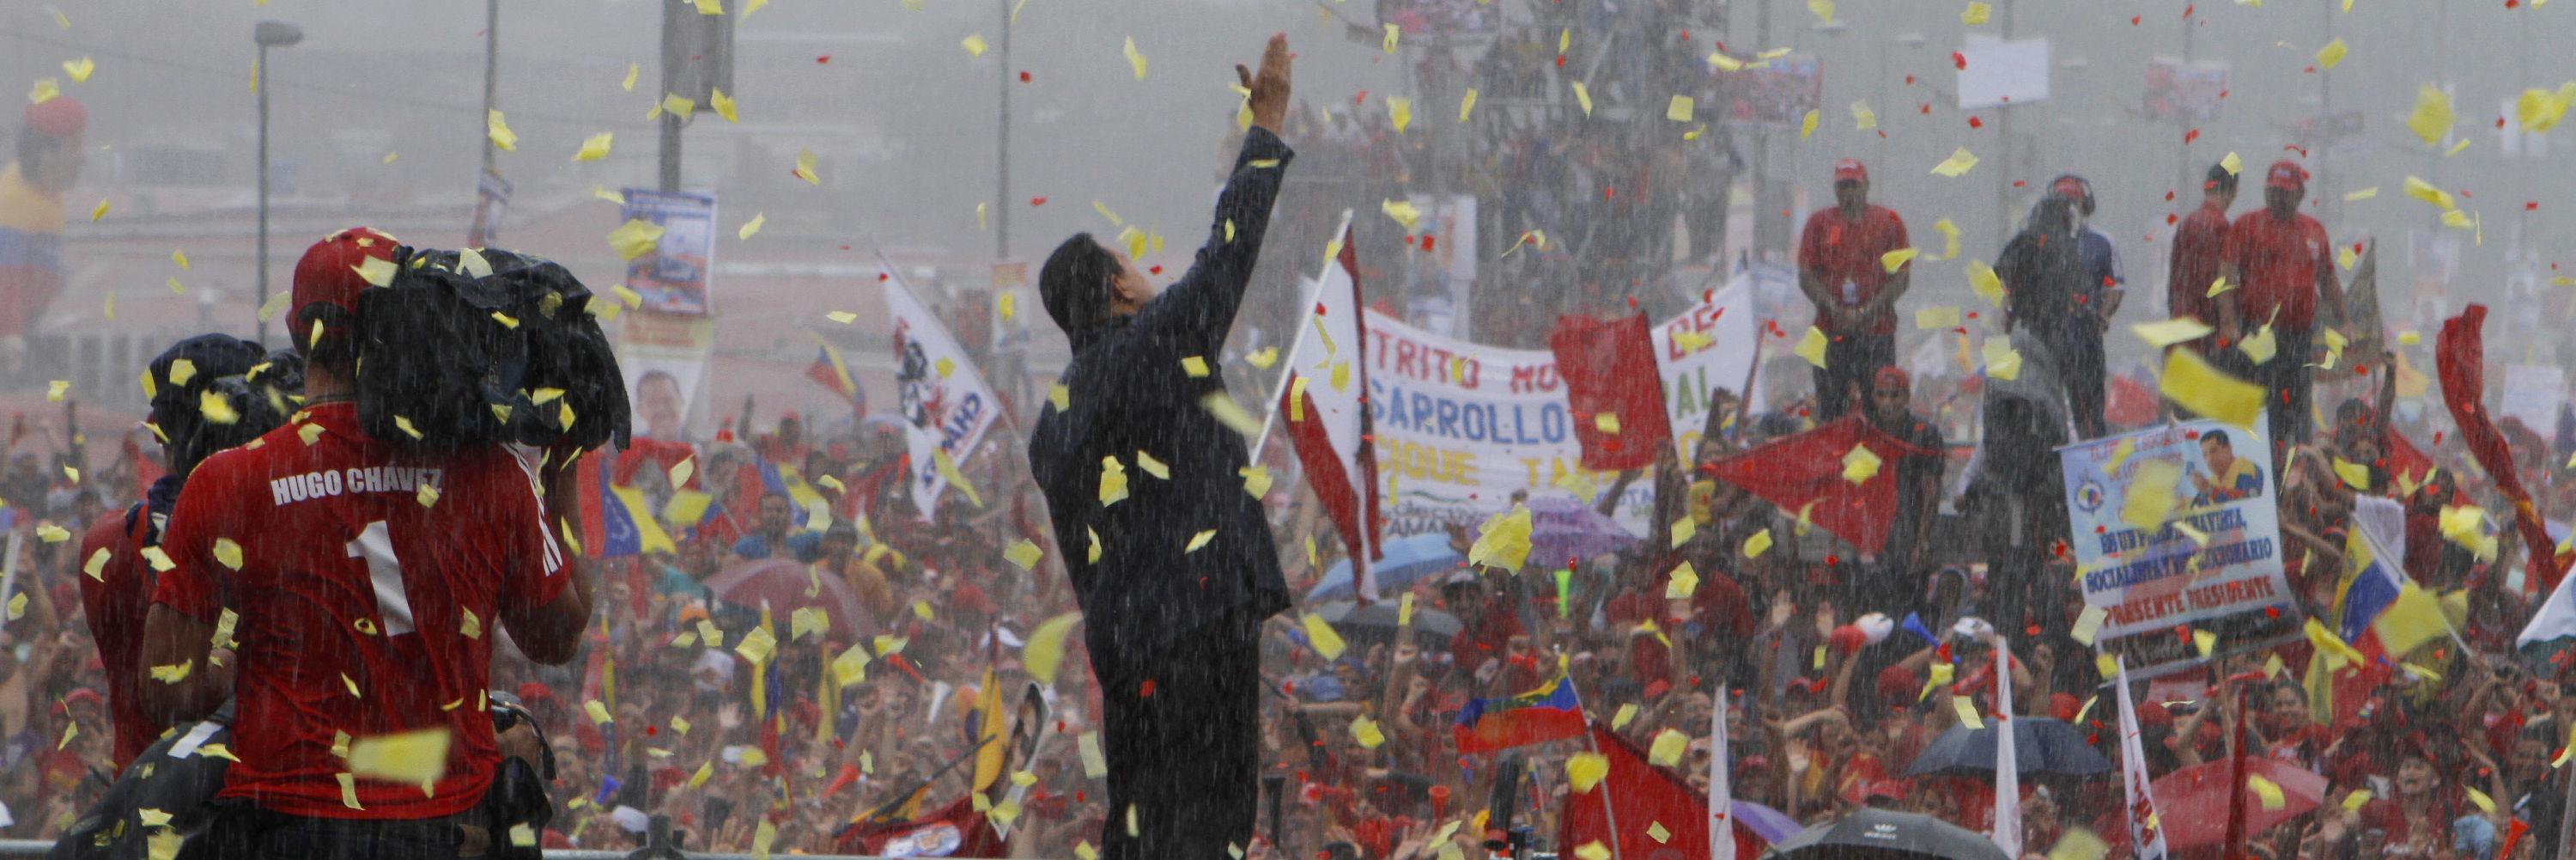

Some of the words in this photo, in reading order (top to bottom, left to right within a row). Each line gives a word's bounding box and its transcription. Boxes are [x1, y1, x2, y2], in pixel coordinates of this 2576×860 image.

[270, 469, 342, 506] HUGO
[346, 460, 442, 495] CHÁVEZ
[345, 519, 416, 637] 1
[2085, 557, 2161, 593] SOCIALISTA
[2185, 574, 2276, 612] PRESIDENTE
